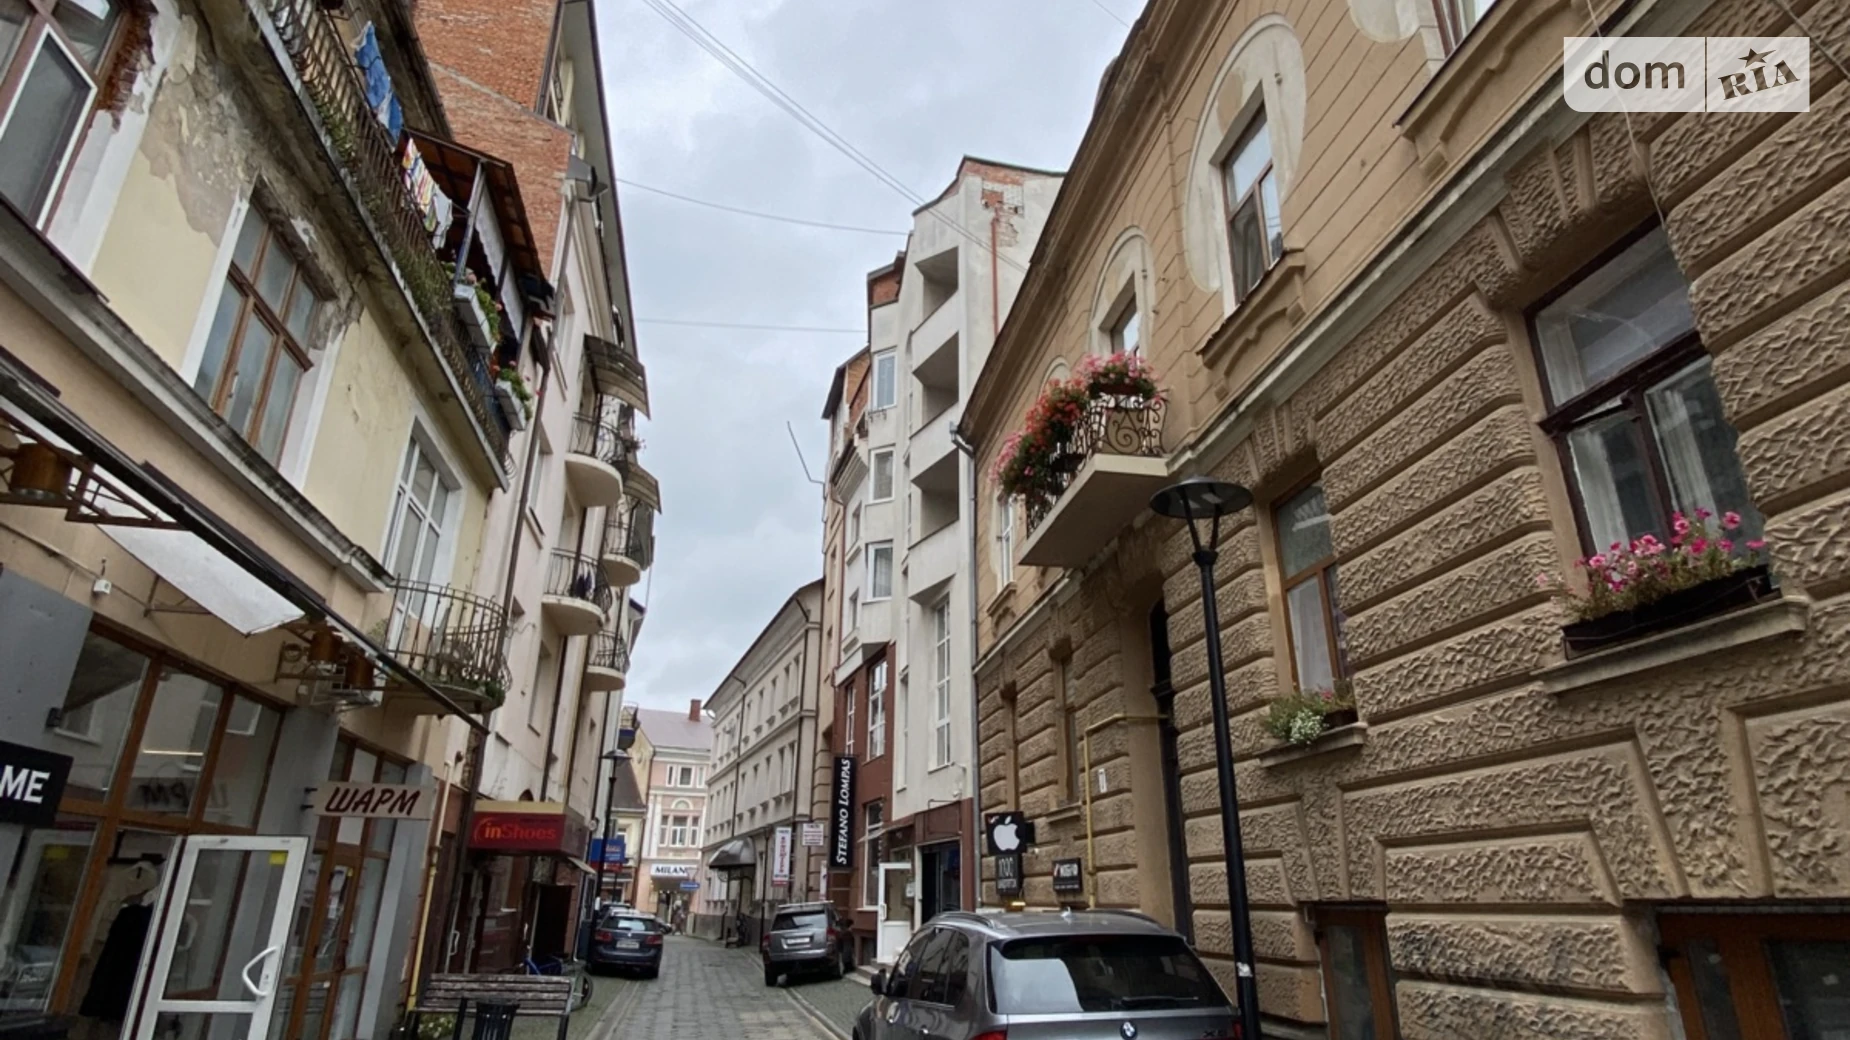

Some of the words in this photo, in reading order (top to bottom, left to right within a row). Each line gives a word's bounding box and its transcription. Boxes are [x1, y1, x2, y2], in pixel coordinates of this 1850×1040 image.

[838, 758, 851, 806] LOMPAS
[325, 786, 421, 816] ШАРМ
[484, 822, 557, 840] inShoes
[836, 809, 849, 865] STEFANO
[655, 866, 689, 875] MILAN
